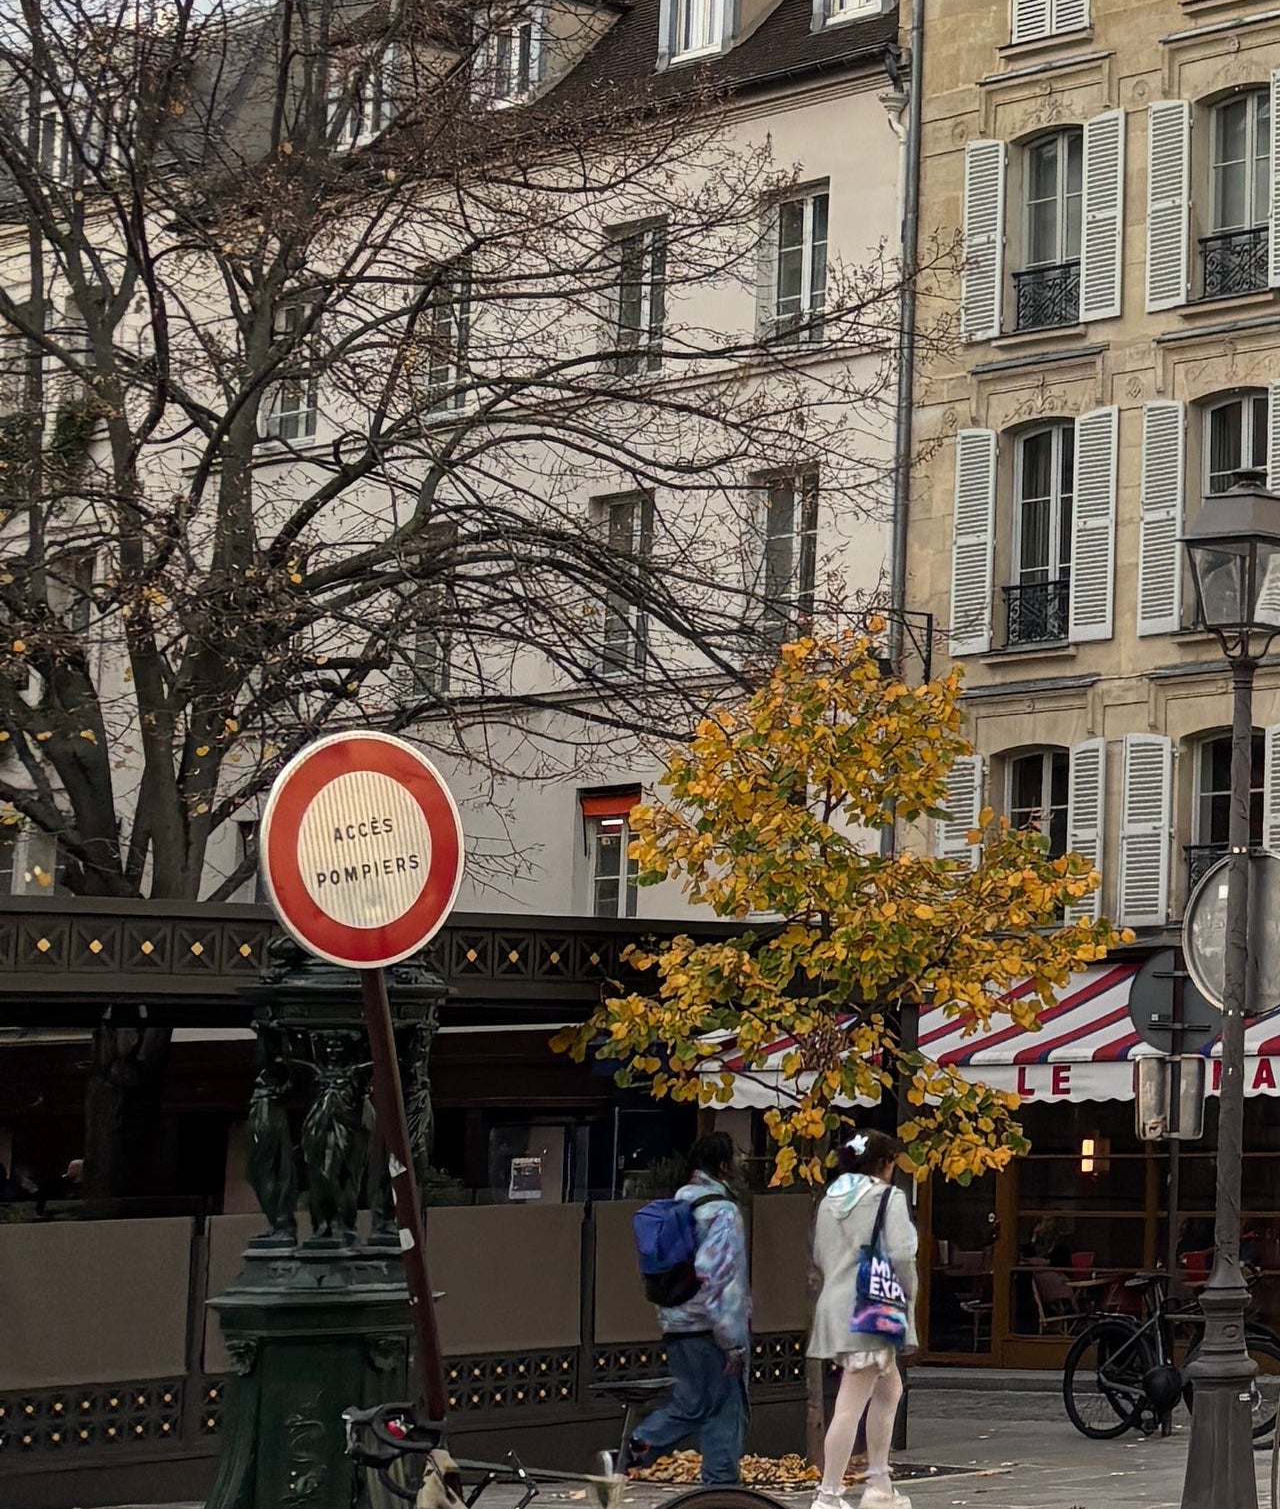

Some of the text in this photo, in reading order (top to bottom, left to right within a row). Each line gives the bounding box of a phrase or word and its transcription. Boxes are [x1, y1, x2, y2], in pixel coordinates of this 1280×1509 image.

[334, 816, 393, 844] ACCÈS
[317, 854, 419, 888] POMPIERS
[1017, 1065, 1072, 1096] LE
